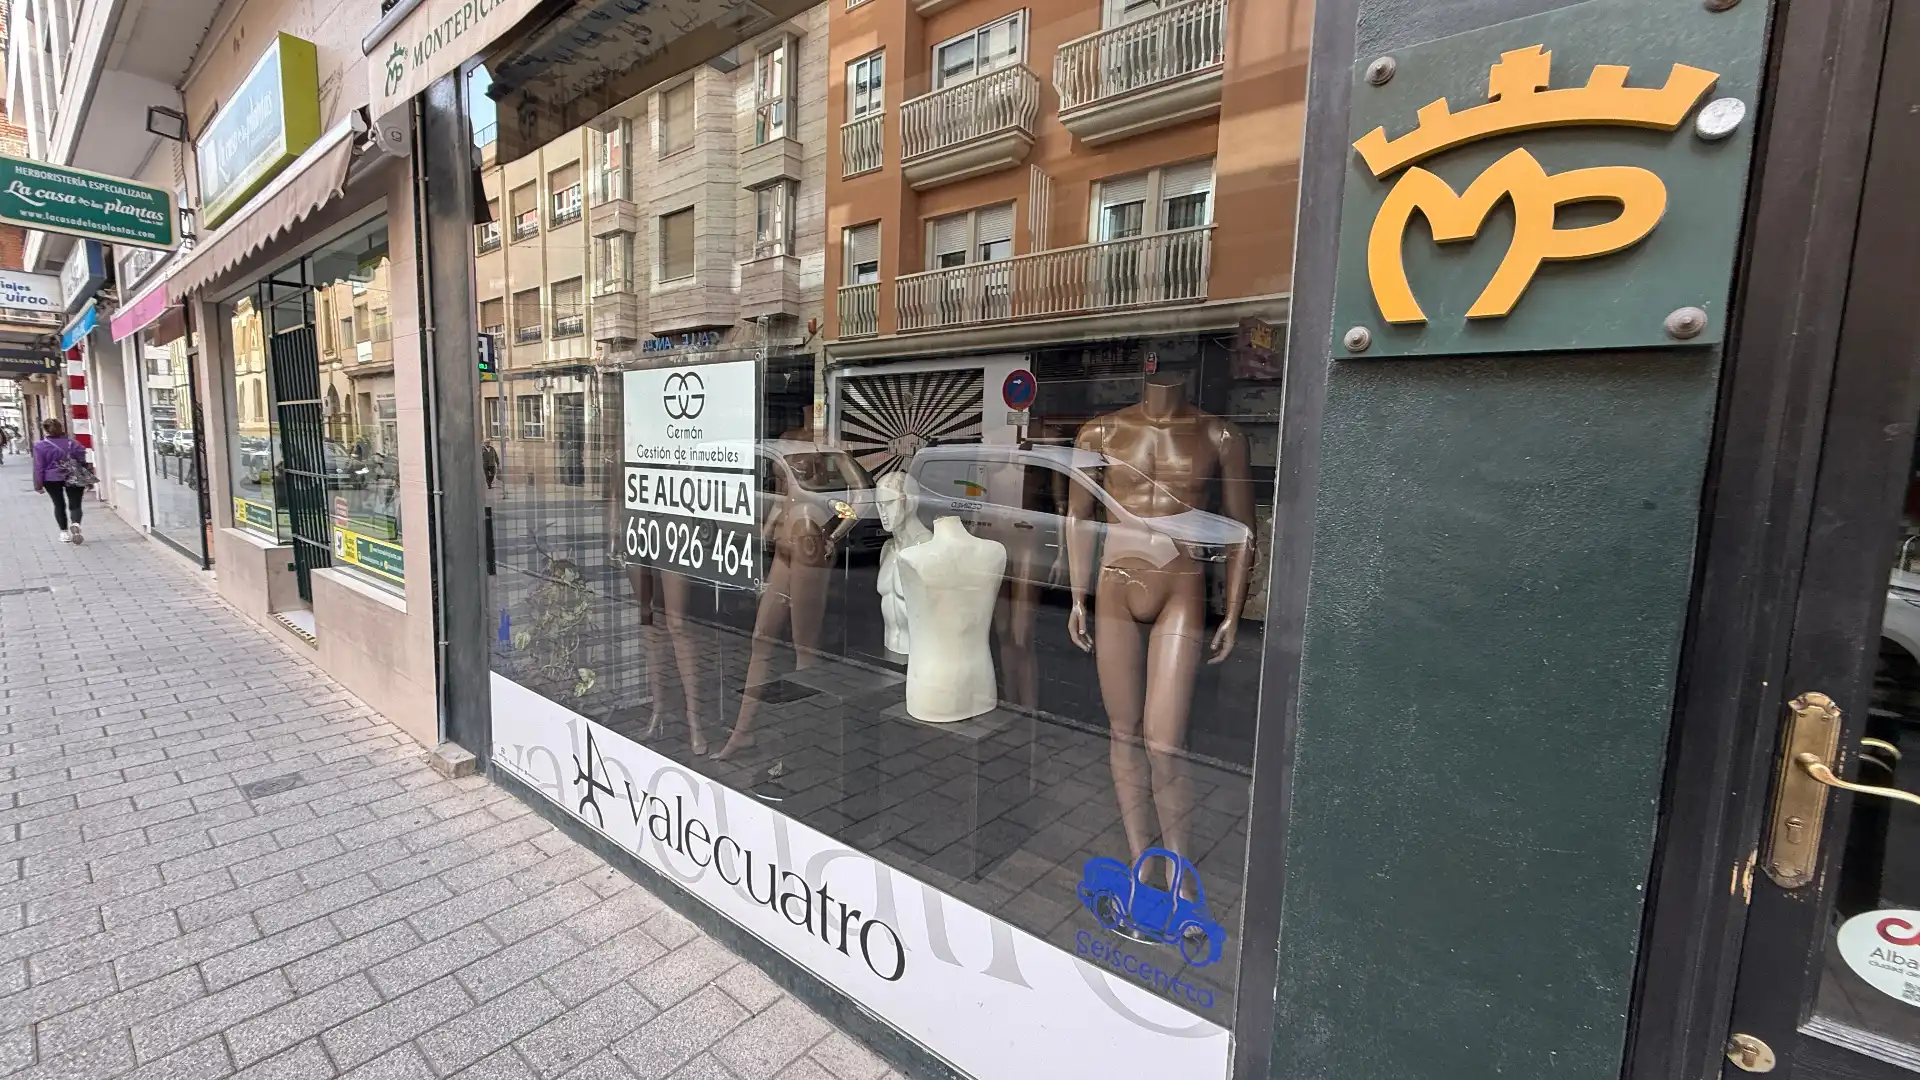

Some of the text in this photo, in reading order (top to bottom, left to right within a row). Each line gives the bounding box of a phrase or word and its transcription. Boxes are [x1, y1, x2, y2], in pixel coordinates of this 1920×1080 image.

[14, 165, 153, 201] HERBORISTERÍA ESPECIALIZADA
[3, 180, 46, 207] La
[35, 188, 77, 205] casa
[104, 198, 165, 222] plantas
[19, 209, 156, 239] www.lacasadelasplantas.com
[0, 281, 31, 292] iajes
[3, 292, 48, 305] uirao
[666, 424, 703, 439] Germán
[636, 444, 739, 463] Gestión de inmuebles
[627, 473, 752, 516] SE ALQUILA
[626, 516, 754, 579] 650 926 464
[624, 780, 906, 982] valecuatro
